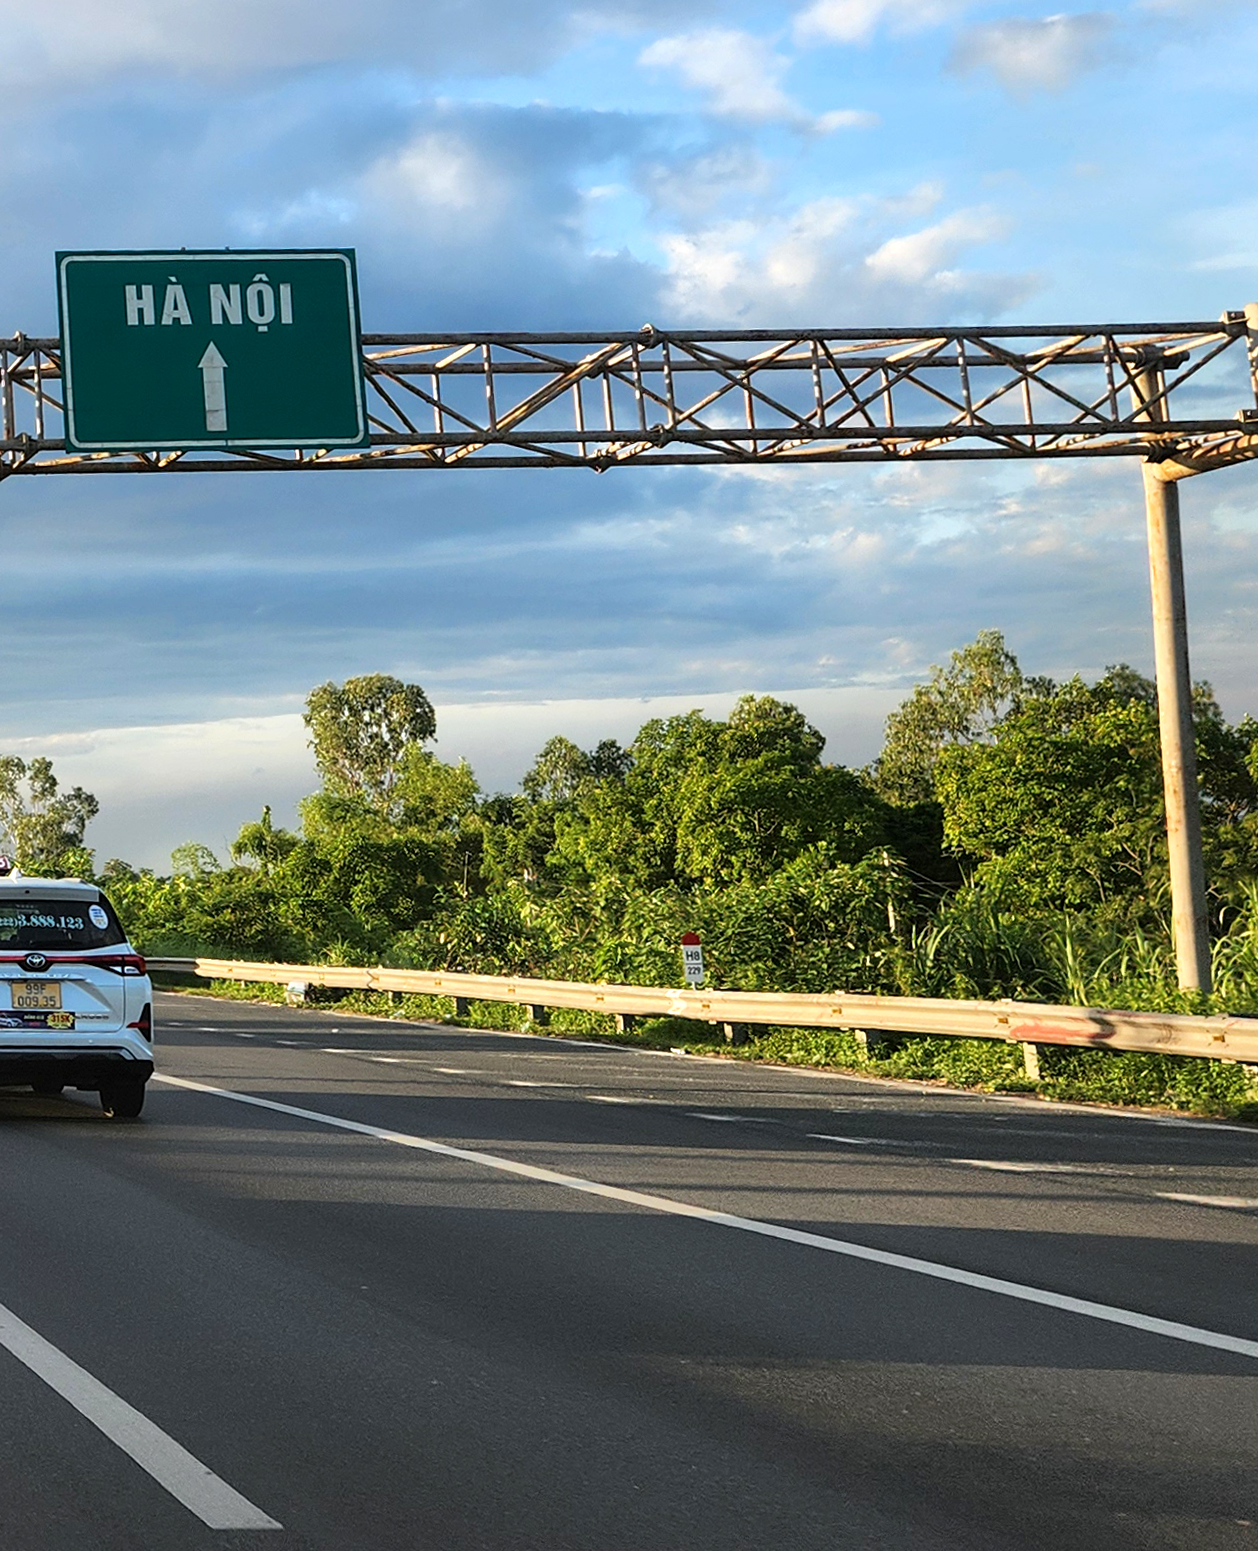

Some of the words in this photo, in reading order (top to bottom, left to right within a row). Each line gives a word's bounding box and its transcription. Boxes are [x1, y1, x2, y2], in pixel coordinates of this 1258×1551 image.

[125, 276, 192, 326] HÀ
[209, 273, 293, 332] NỘI
[685, 950, 701, 961] H8
